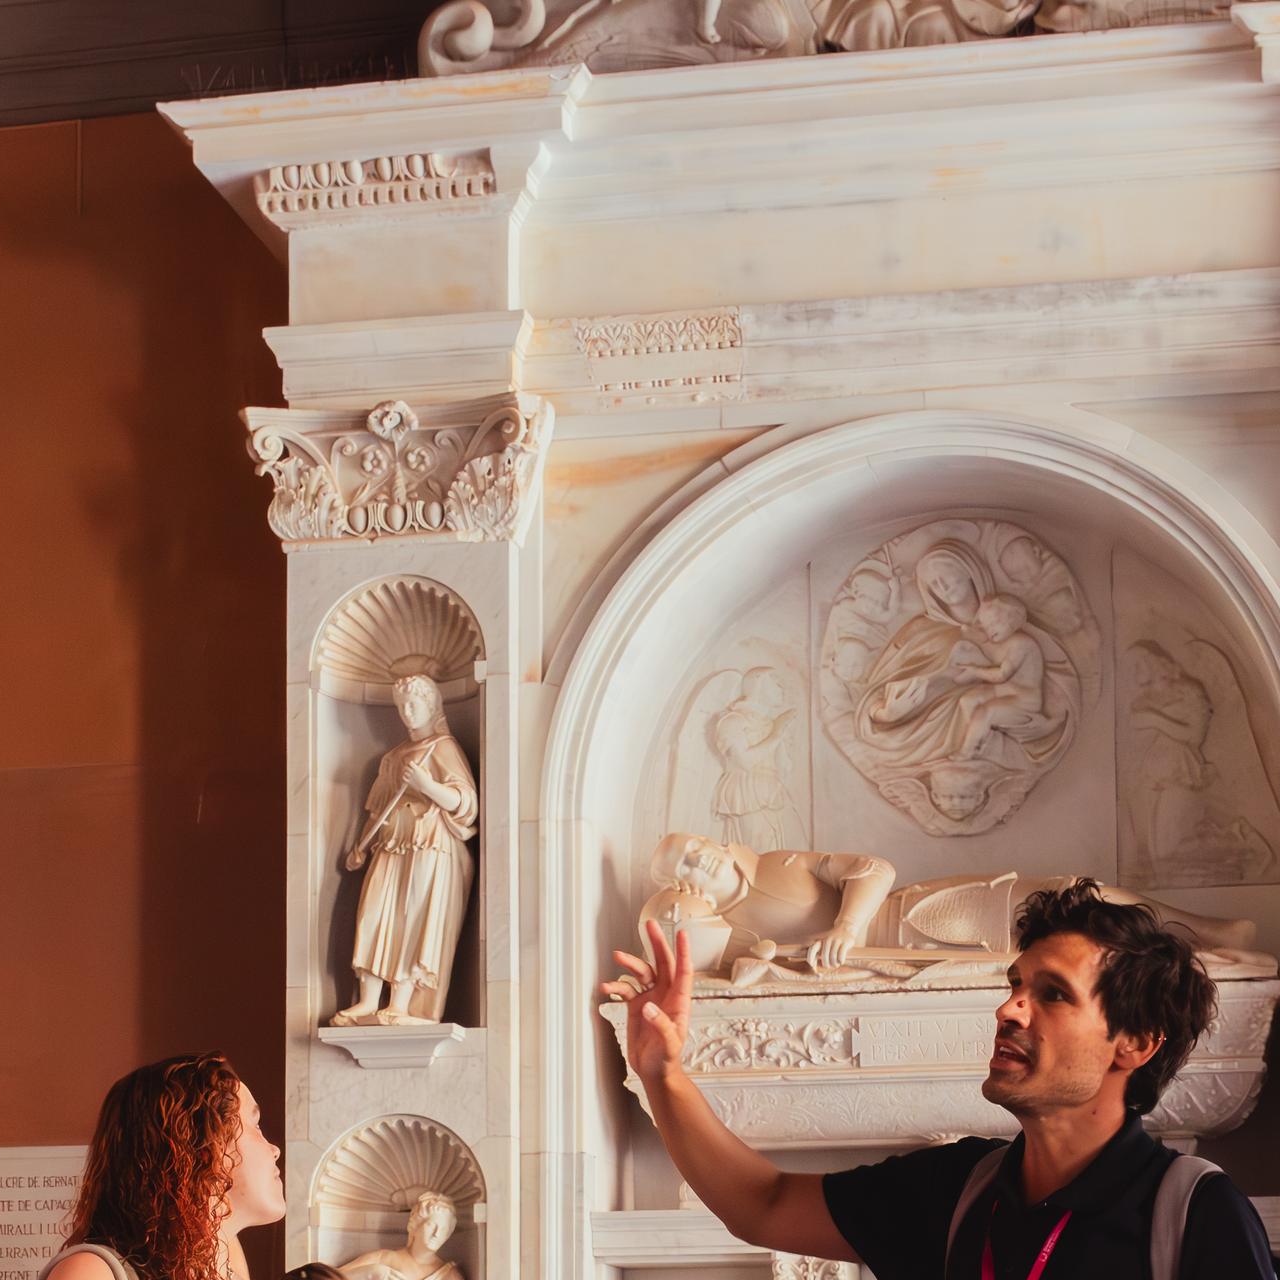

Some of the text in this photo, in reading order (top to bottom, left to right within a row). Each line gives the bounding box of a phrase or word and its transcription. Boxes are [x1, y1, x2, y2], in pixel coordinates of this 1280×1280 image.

[28, 1177, 40, 1188] DE
[18, 1200, 32, 1211] DE
[40, 1223, 43, 1235] I
